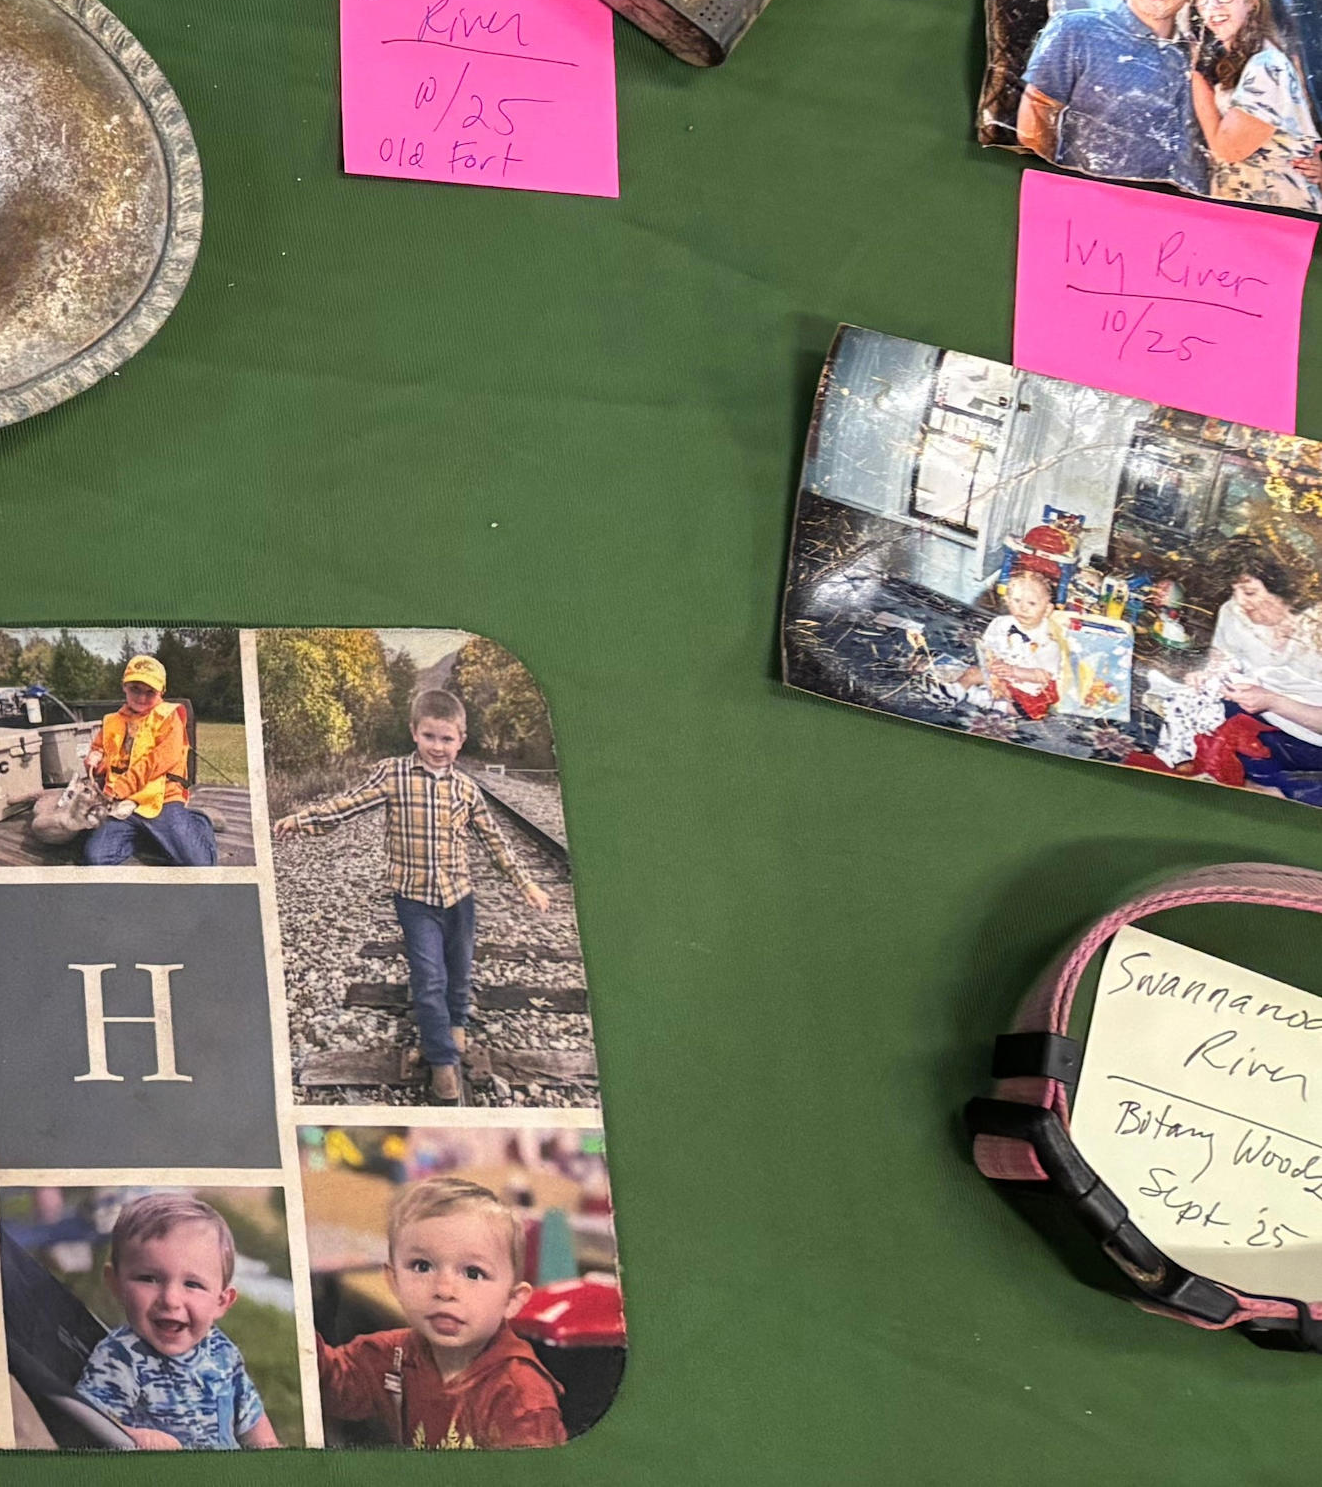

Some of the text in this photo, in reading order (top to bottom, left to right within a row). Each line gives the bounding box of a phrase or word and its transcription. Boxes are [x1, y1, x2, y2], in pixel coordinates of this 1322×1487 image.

[379, 137, 524, 177] Old Fort
[1065, 219, 1269, 297] Ivy River
[1101, 302, 1218, 362] 10/25
[68, 963, 193, 1082] H
[1183, 1030, 1308, 1102] River
[1114, 1100, 1217, 1184] Botany
